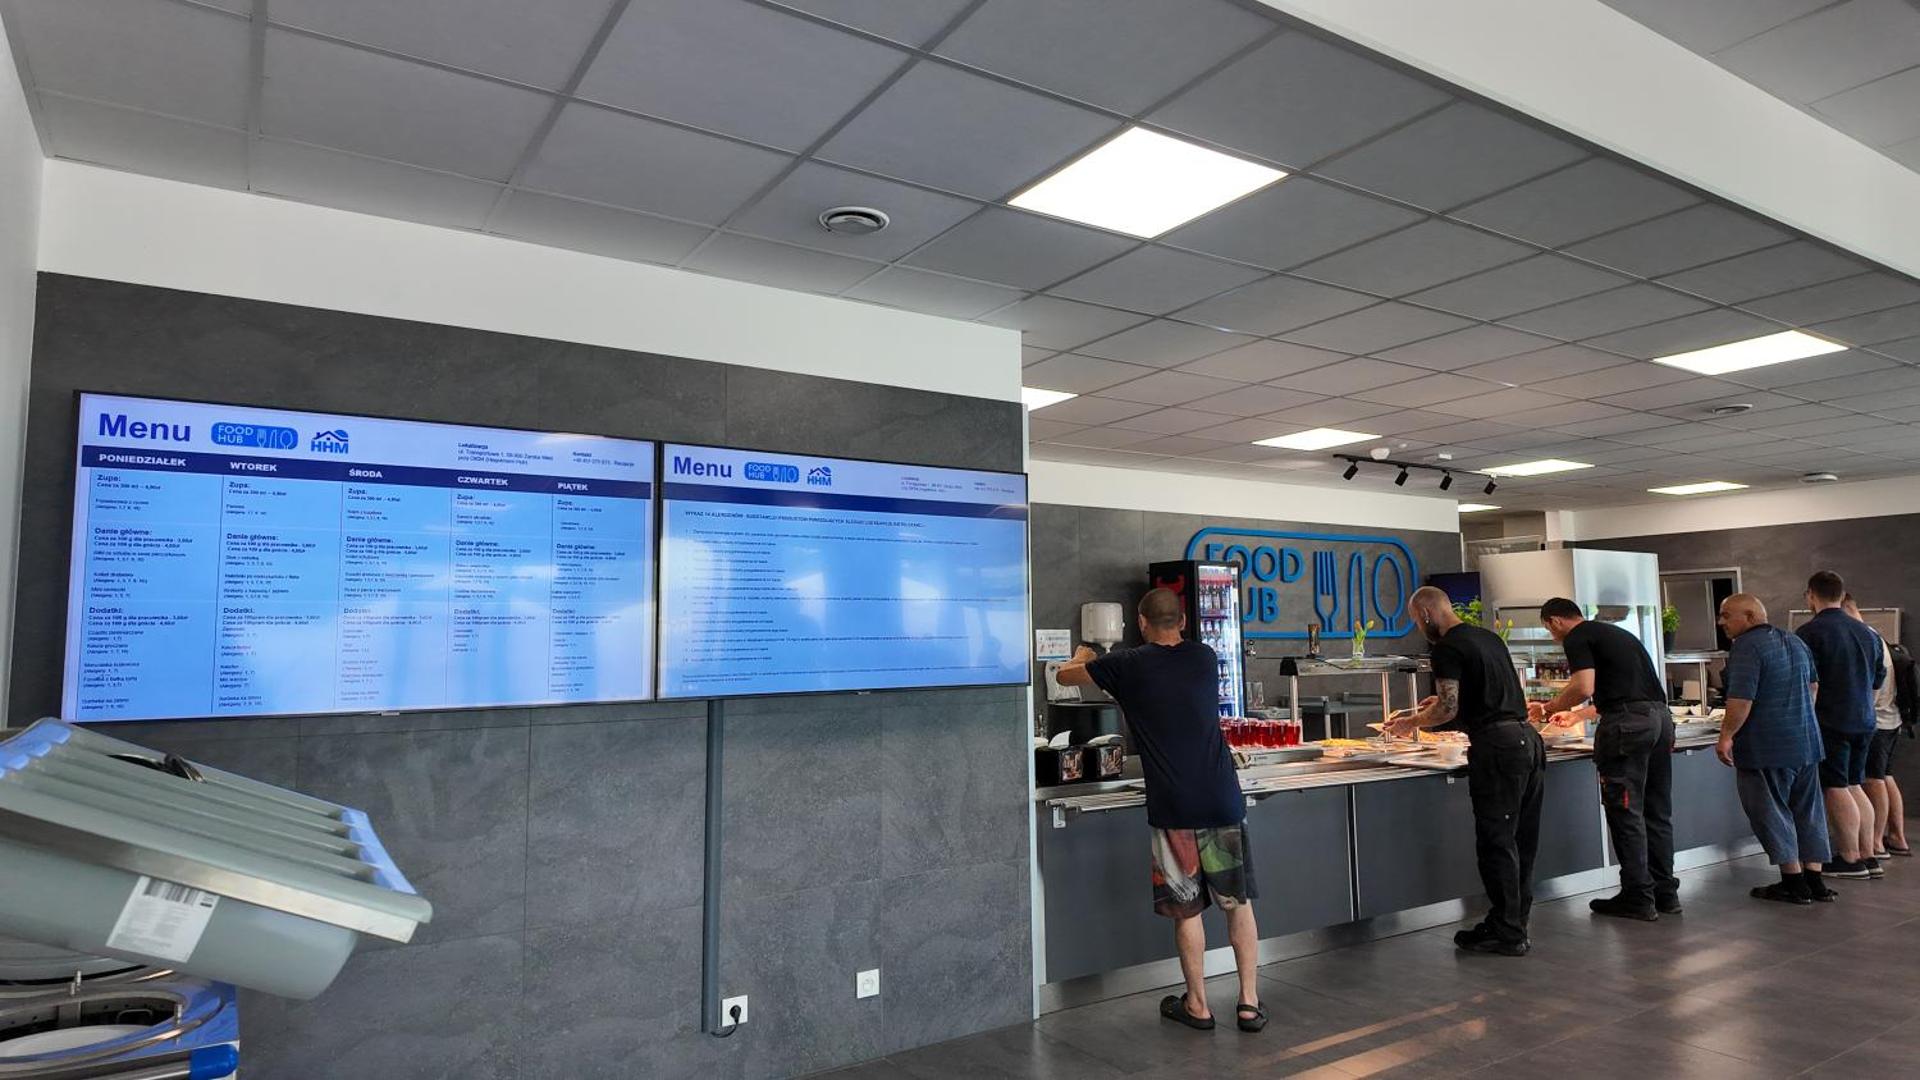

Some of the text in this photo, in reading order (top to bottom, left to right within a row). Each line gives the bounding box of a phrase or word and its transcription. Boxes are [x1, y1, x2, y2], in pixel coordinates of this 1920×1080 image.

[100, 413, 191, 442] Menu
[219, 425, 253, 436] FOOD
[219, 434, 243, 444] HUB
[311, 440, 348, 454] HHM
[99, 454, 187, 467] PONIEDZIAŁEK
[230, 462, 277, 472] WTOREK
[674, 456, 732, 478] Menu
[748, 464, 771, 472] FOOD
[348, 468, 383, 478] ŚRODA
[748, 471, 765, 479] HUB
[457, 476, 509, 487] CZWARTEK
[807, 475, 832, 486] HHM
[557, 482, 588, 492] PIĄTEK
[1243, 587, 1280, 623] UB
